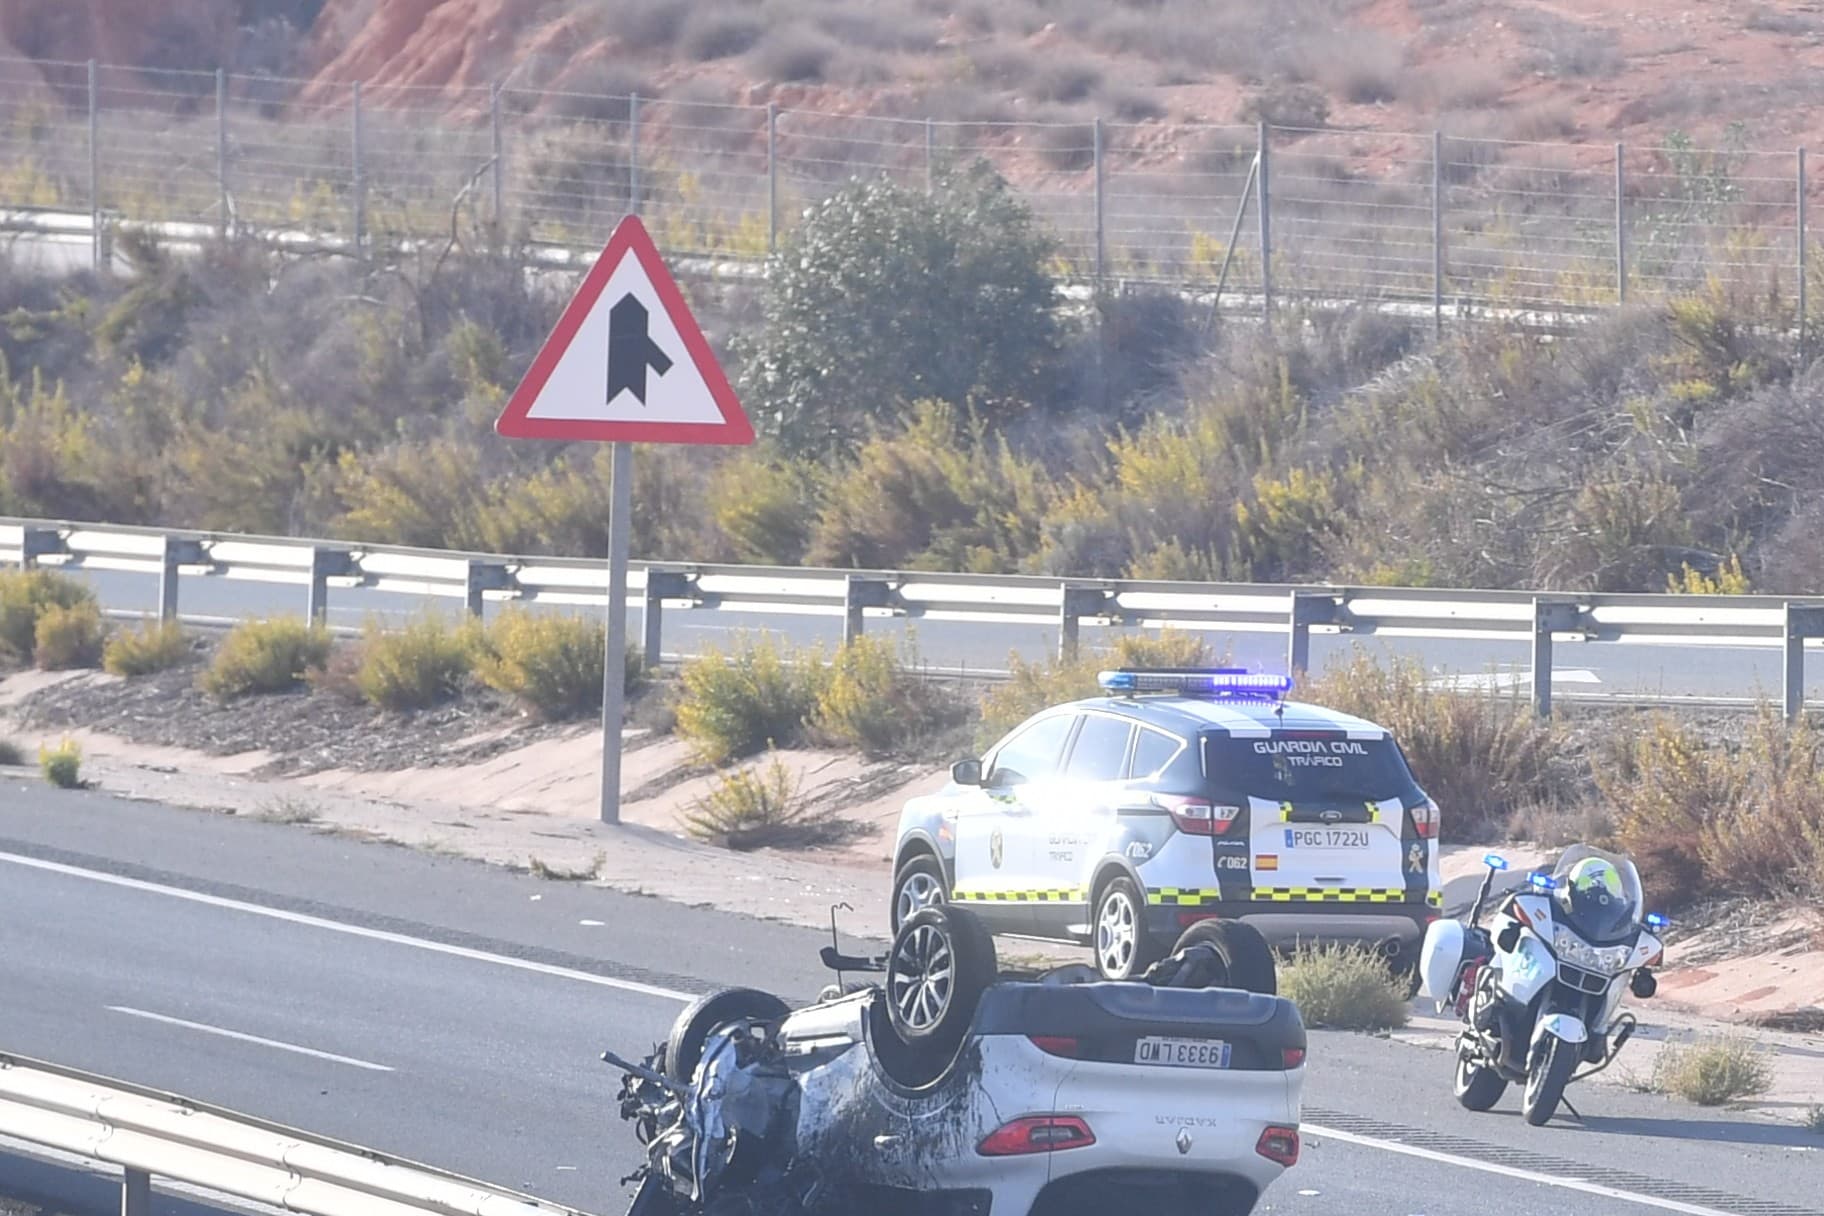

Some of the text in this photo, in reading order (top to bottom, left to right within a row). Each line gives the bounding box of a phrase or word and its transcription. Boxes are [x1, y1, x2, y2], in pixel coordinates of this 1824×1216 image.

[1253, 740, 1369, 755] GUARDIA CIVIL
[1287, 754, 1343, 767] TRÁFICO
[1293, 830, 1322, 846] PGC
[1227, 857, 1248, 870] 062
[1177, 1044, 1219, 1064] 9333
